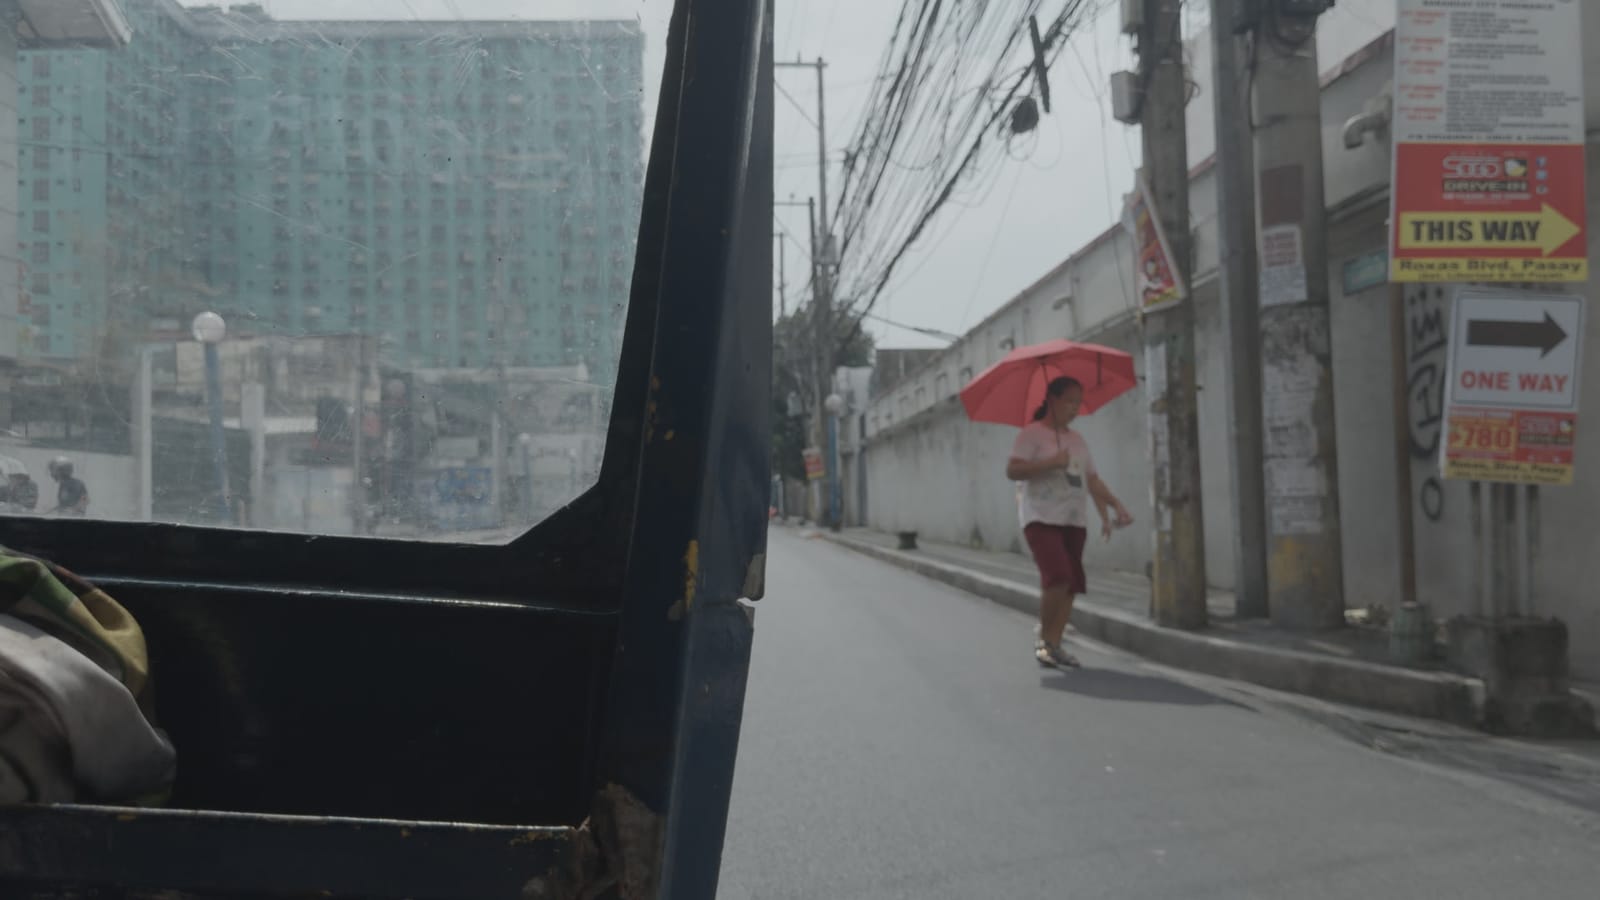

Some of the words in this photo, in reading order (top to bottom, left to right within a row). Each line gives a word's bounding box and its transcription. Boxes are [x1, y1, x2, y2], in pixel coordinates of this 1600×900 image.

[1410, 220, 1473, 242] THIS
[1480, 220, 1541, 242] WAY
[1400, 260, 1459, 271] Roxas
[1522, 260, 1582, 273] Pasay
[1459, 369, 1509, 391] ONE
[1518, 373, 1568, 393] WAY
